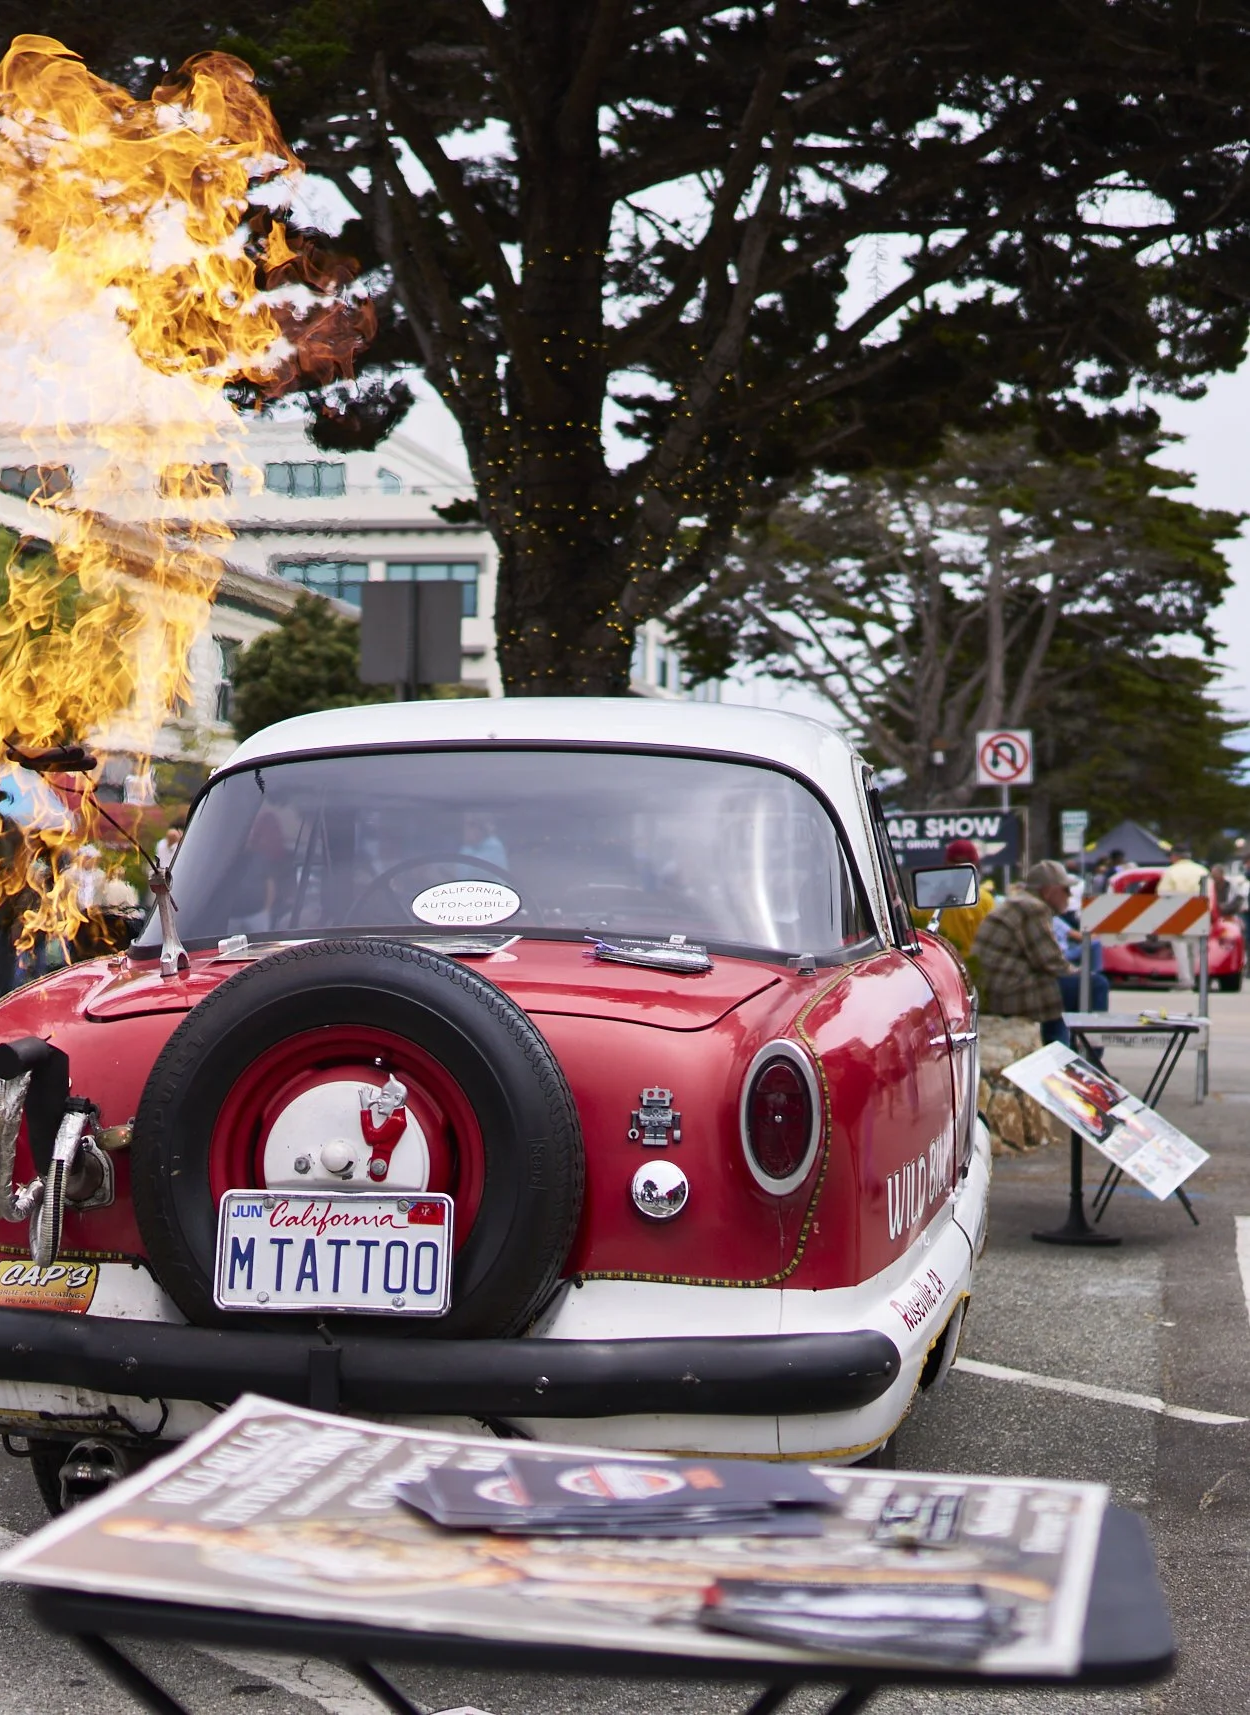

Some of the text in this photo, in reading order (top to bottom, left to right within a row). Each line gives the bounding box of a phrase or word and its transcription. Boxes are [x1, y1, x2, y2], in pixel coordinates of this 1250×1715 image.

[888, 816, 1001, 838] AR SHOW
[906, 839, 940, 850] GROVE
[432, 886, 502, 898] CALIFORNIA
[420, 900, 515, 909] AUTOMOBILE
[437, 913, 494, 922] MUSEUM
[887, 1152, 927, 1241] WILD
[232, 1204, 263, 1218] JUN
[269, 1201, 409, 1236] California
[0, 1263, 93, 1288] CAP'S
[269, 1238, 439, 1295] TATTOO
[44, 1291, 86, 1299] COATINGS
[890, 1268, 946, 1331] Roseville, CA
[148, 1470, 226, 1504] WILD
